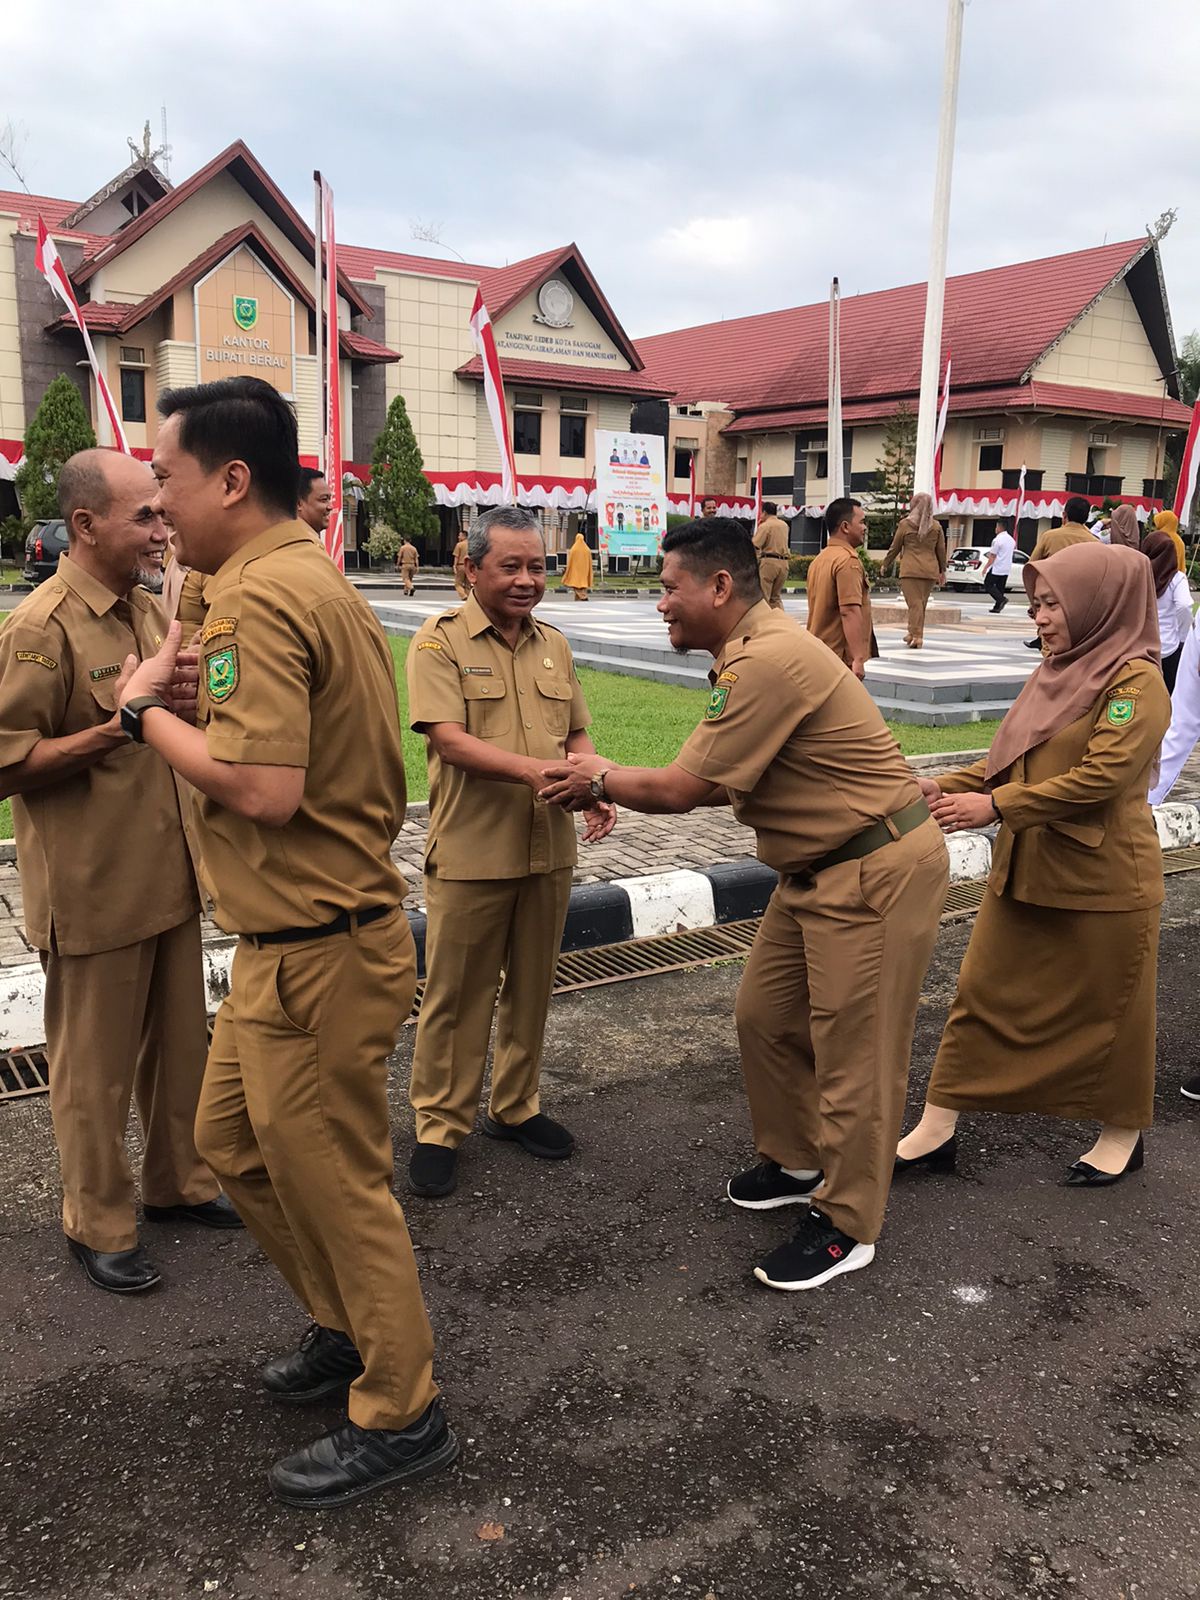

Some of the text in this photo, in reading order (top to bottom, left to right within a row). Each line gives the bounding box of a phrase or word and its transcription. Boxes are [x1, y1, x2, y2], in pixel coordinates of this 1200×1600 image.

[223, 335, 270, 351] KANTOR
[206, 349, 287, 369] BUPATI BERAU
